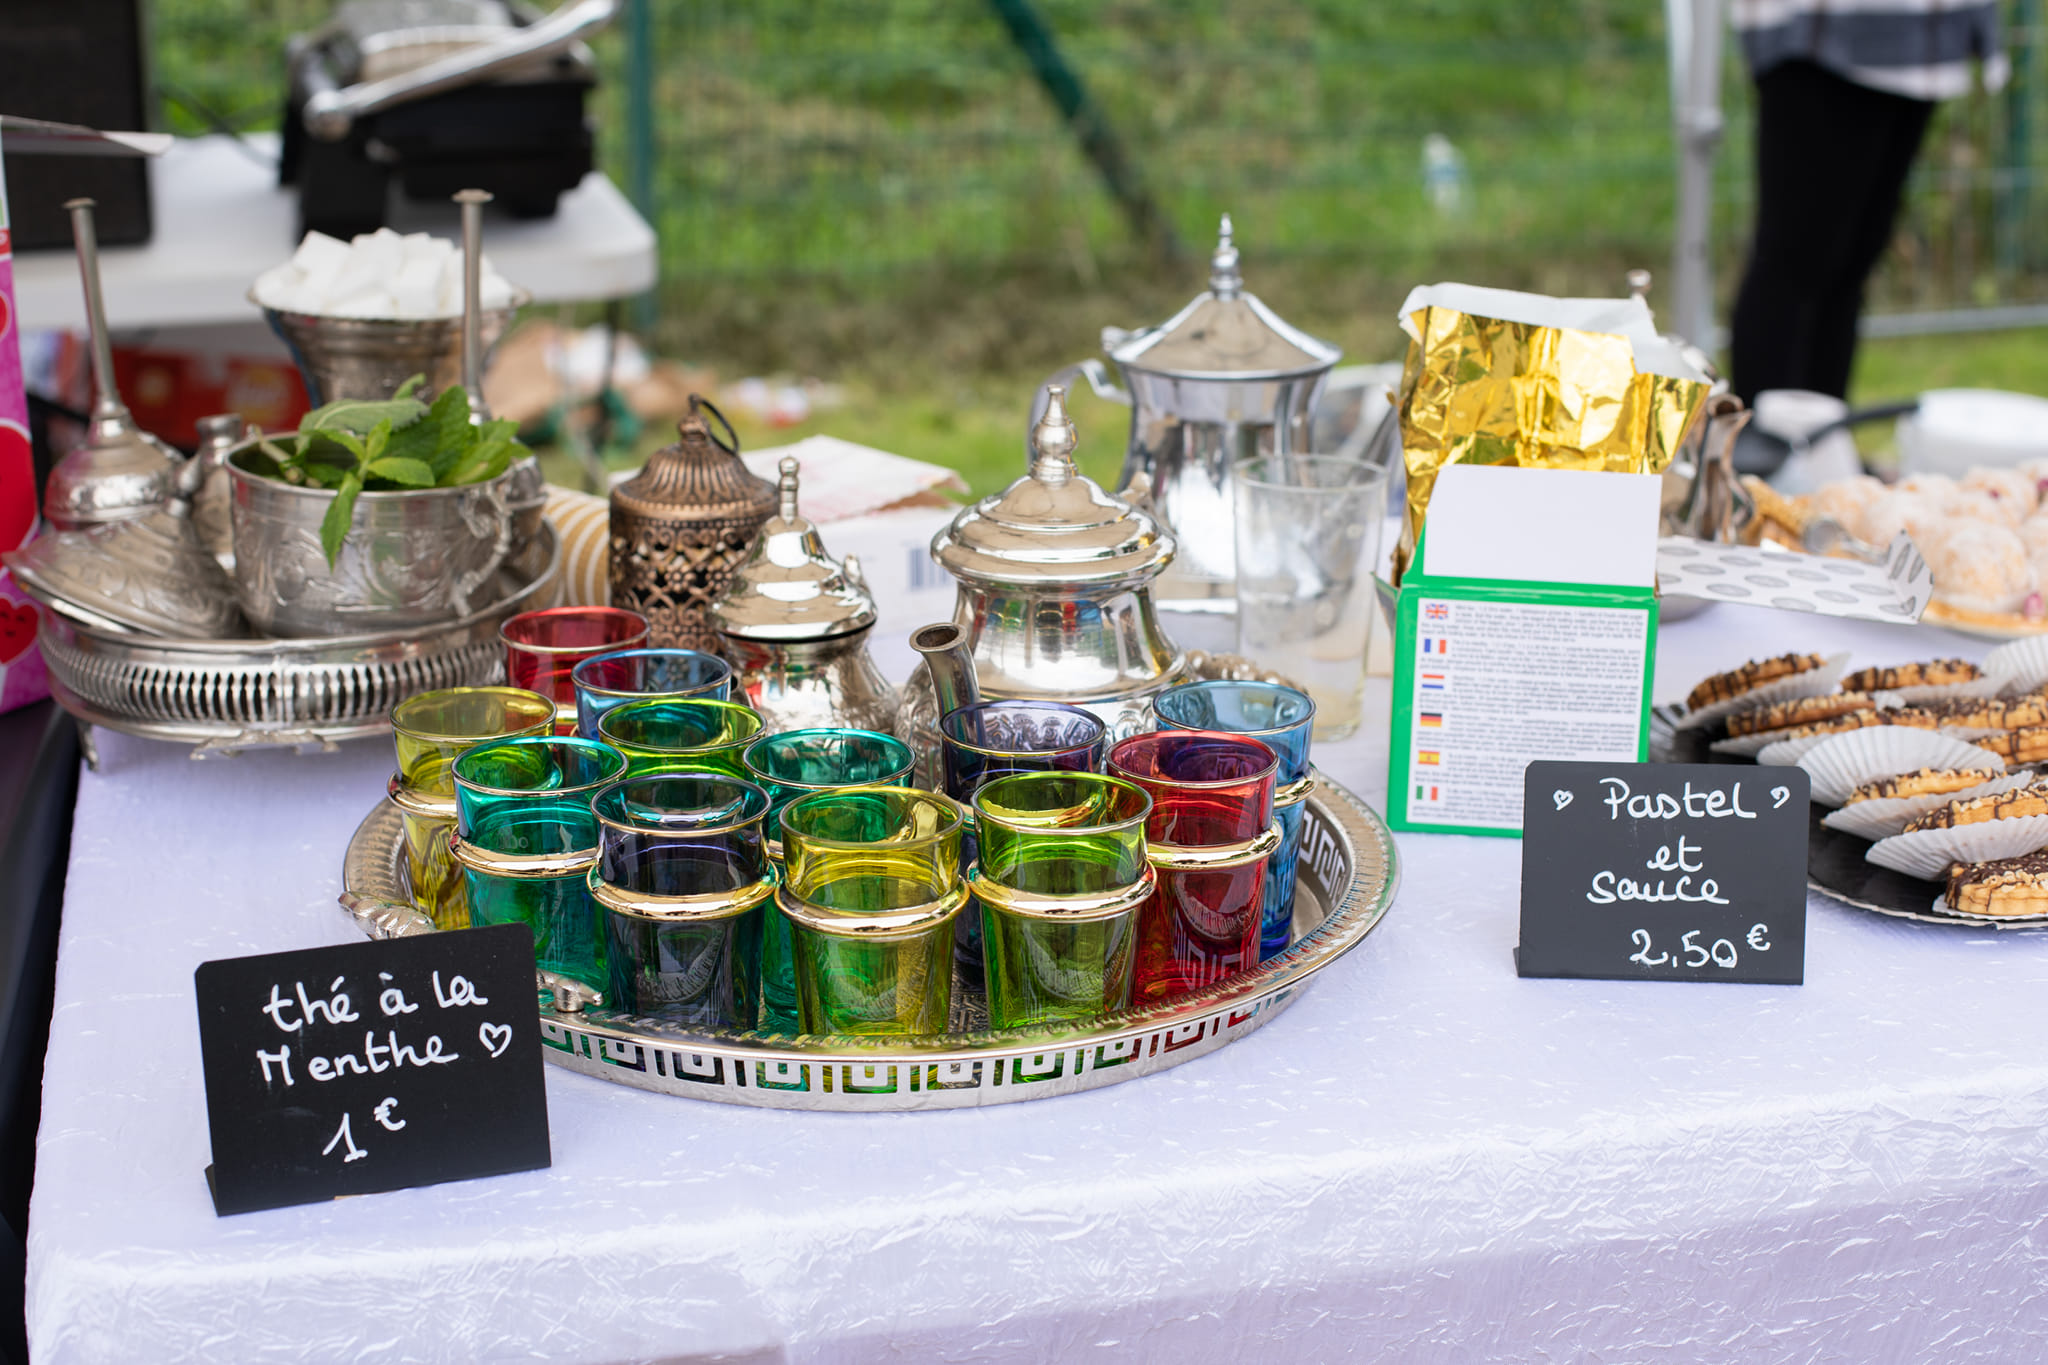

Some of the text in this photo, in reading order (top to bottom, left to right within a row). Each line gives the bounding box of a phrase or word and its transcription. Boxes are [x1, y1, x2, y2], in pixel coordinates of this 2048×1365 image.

[1599, 777, 1757, 820] Pastel
[1646, 835, 1704, 873] et
[1586, 870, 1730, 905] Sauce
[262, 970, 489, 1032] thé à la
[256, 1030, 459, 1086] Menthe
